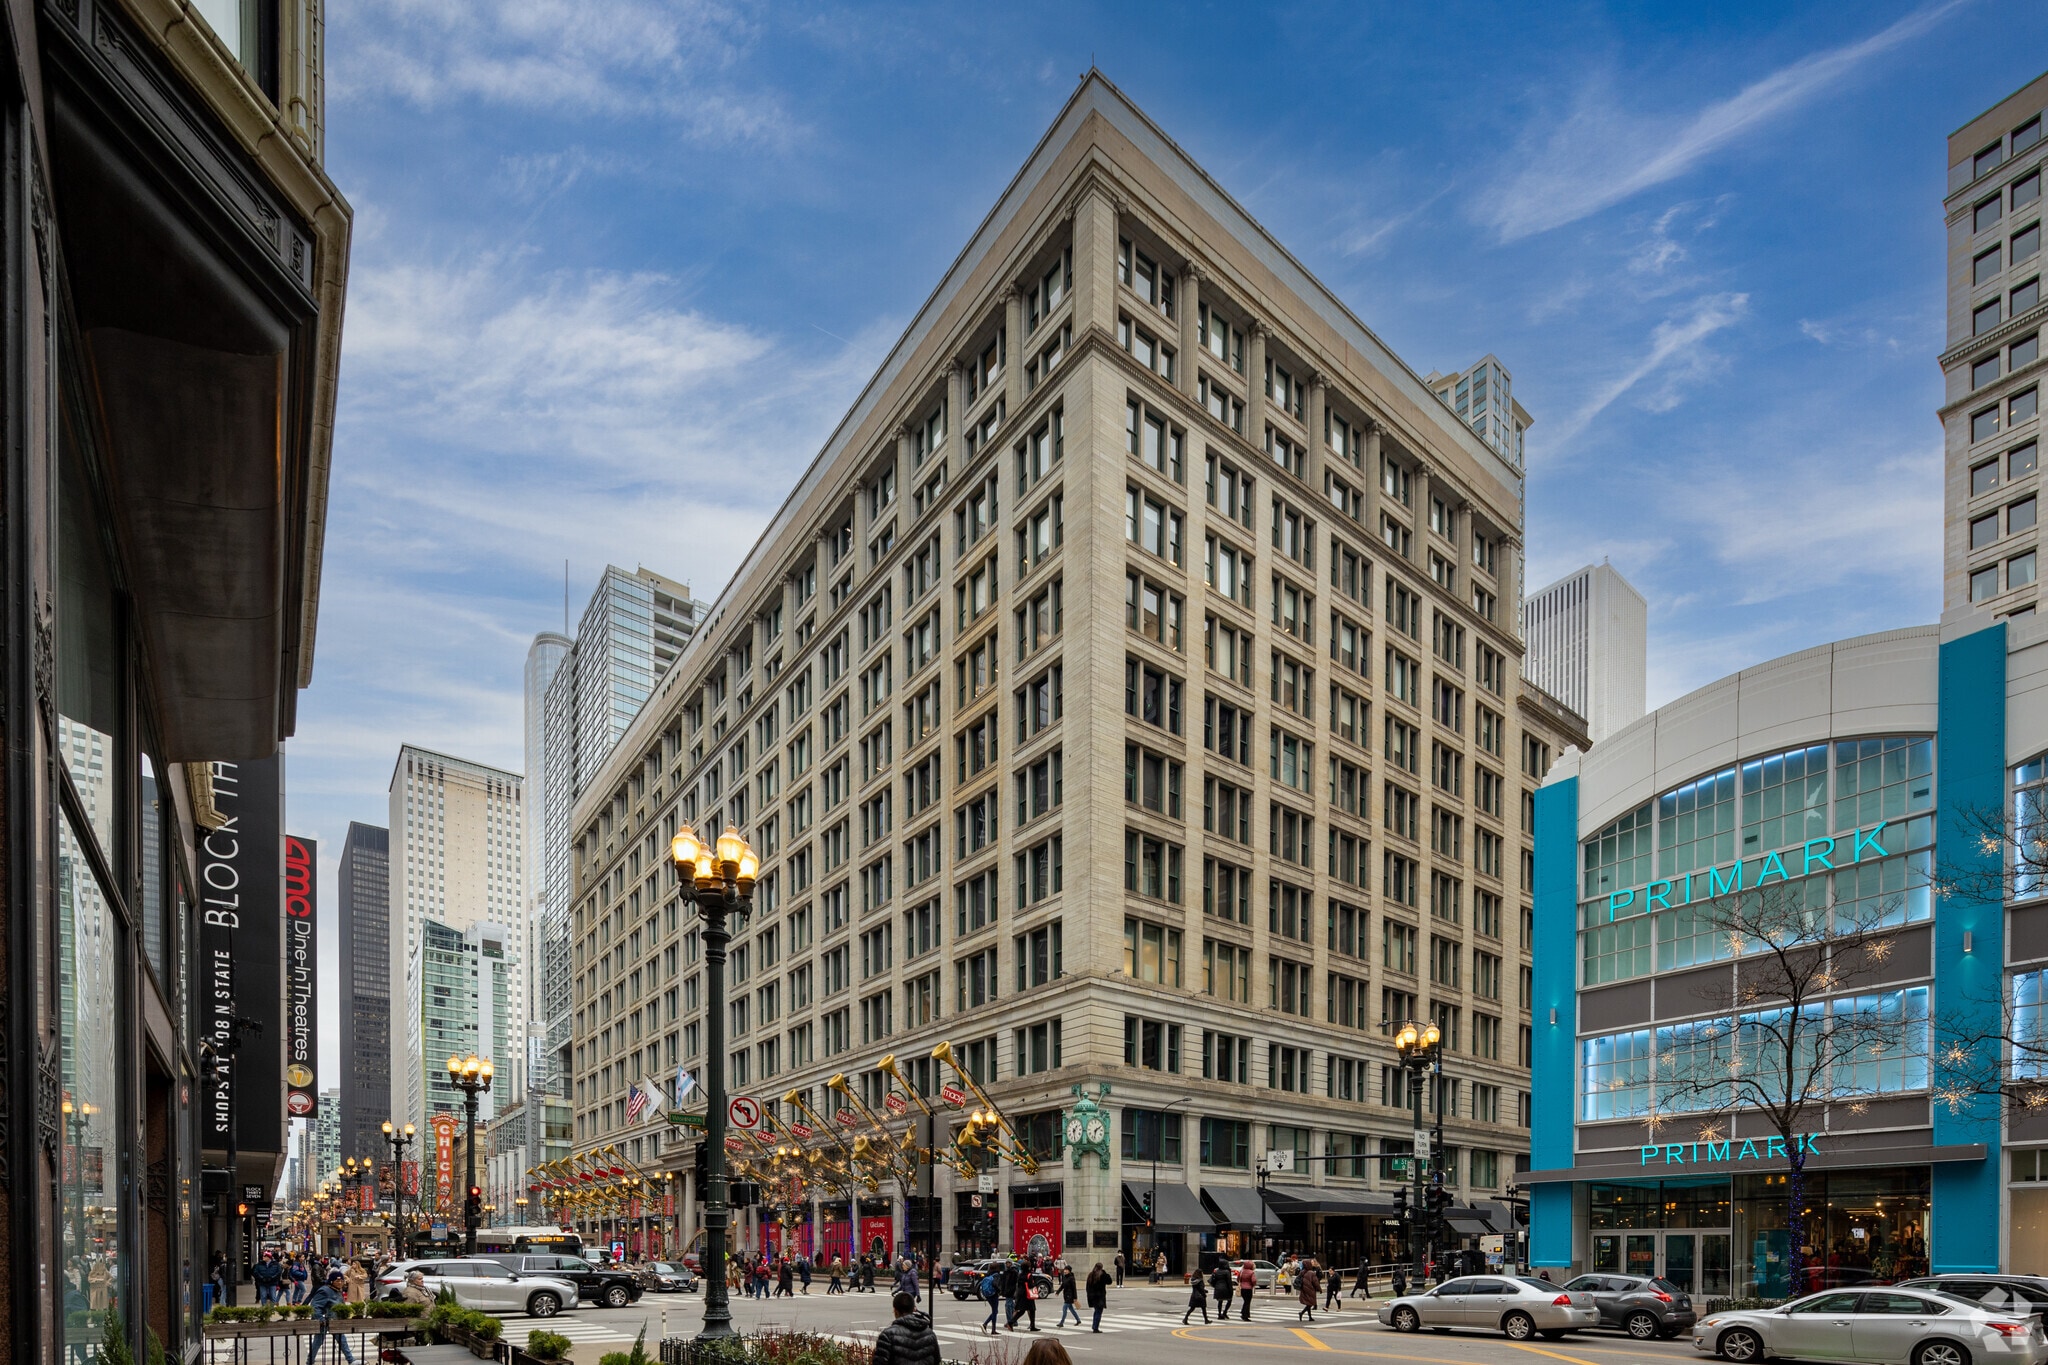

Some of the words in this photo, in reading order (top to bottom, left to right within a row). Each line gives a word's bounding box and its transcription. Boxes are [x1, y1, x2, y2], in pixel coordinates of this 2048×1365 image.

[204, 816, 239, 929] BLOCK
[286, 836, 311, 918] amc
[1609, 821, 1889, 923] PRIMARK
[214, 949, 230, 999] STATE
[214, 1004, 231, 1015] N
[215, 1054, 230, 1074] AT
[215, 1080, 230, 1133] SHOPS
[439, 1124, 451, 1208] CHICAGO
[1641, 1132, 1820, 1167] PRIMARK
